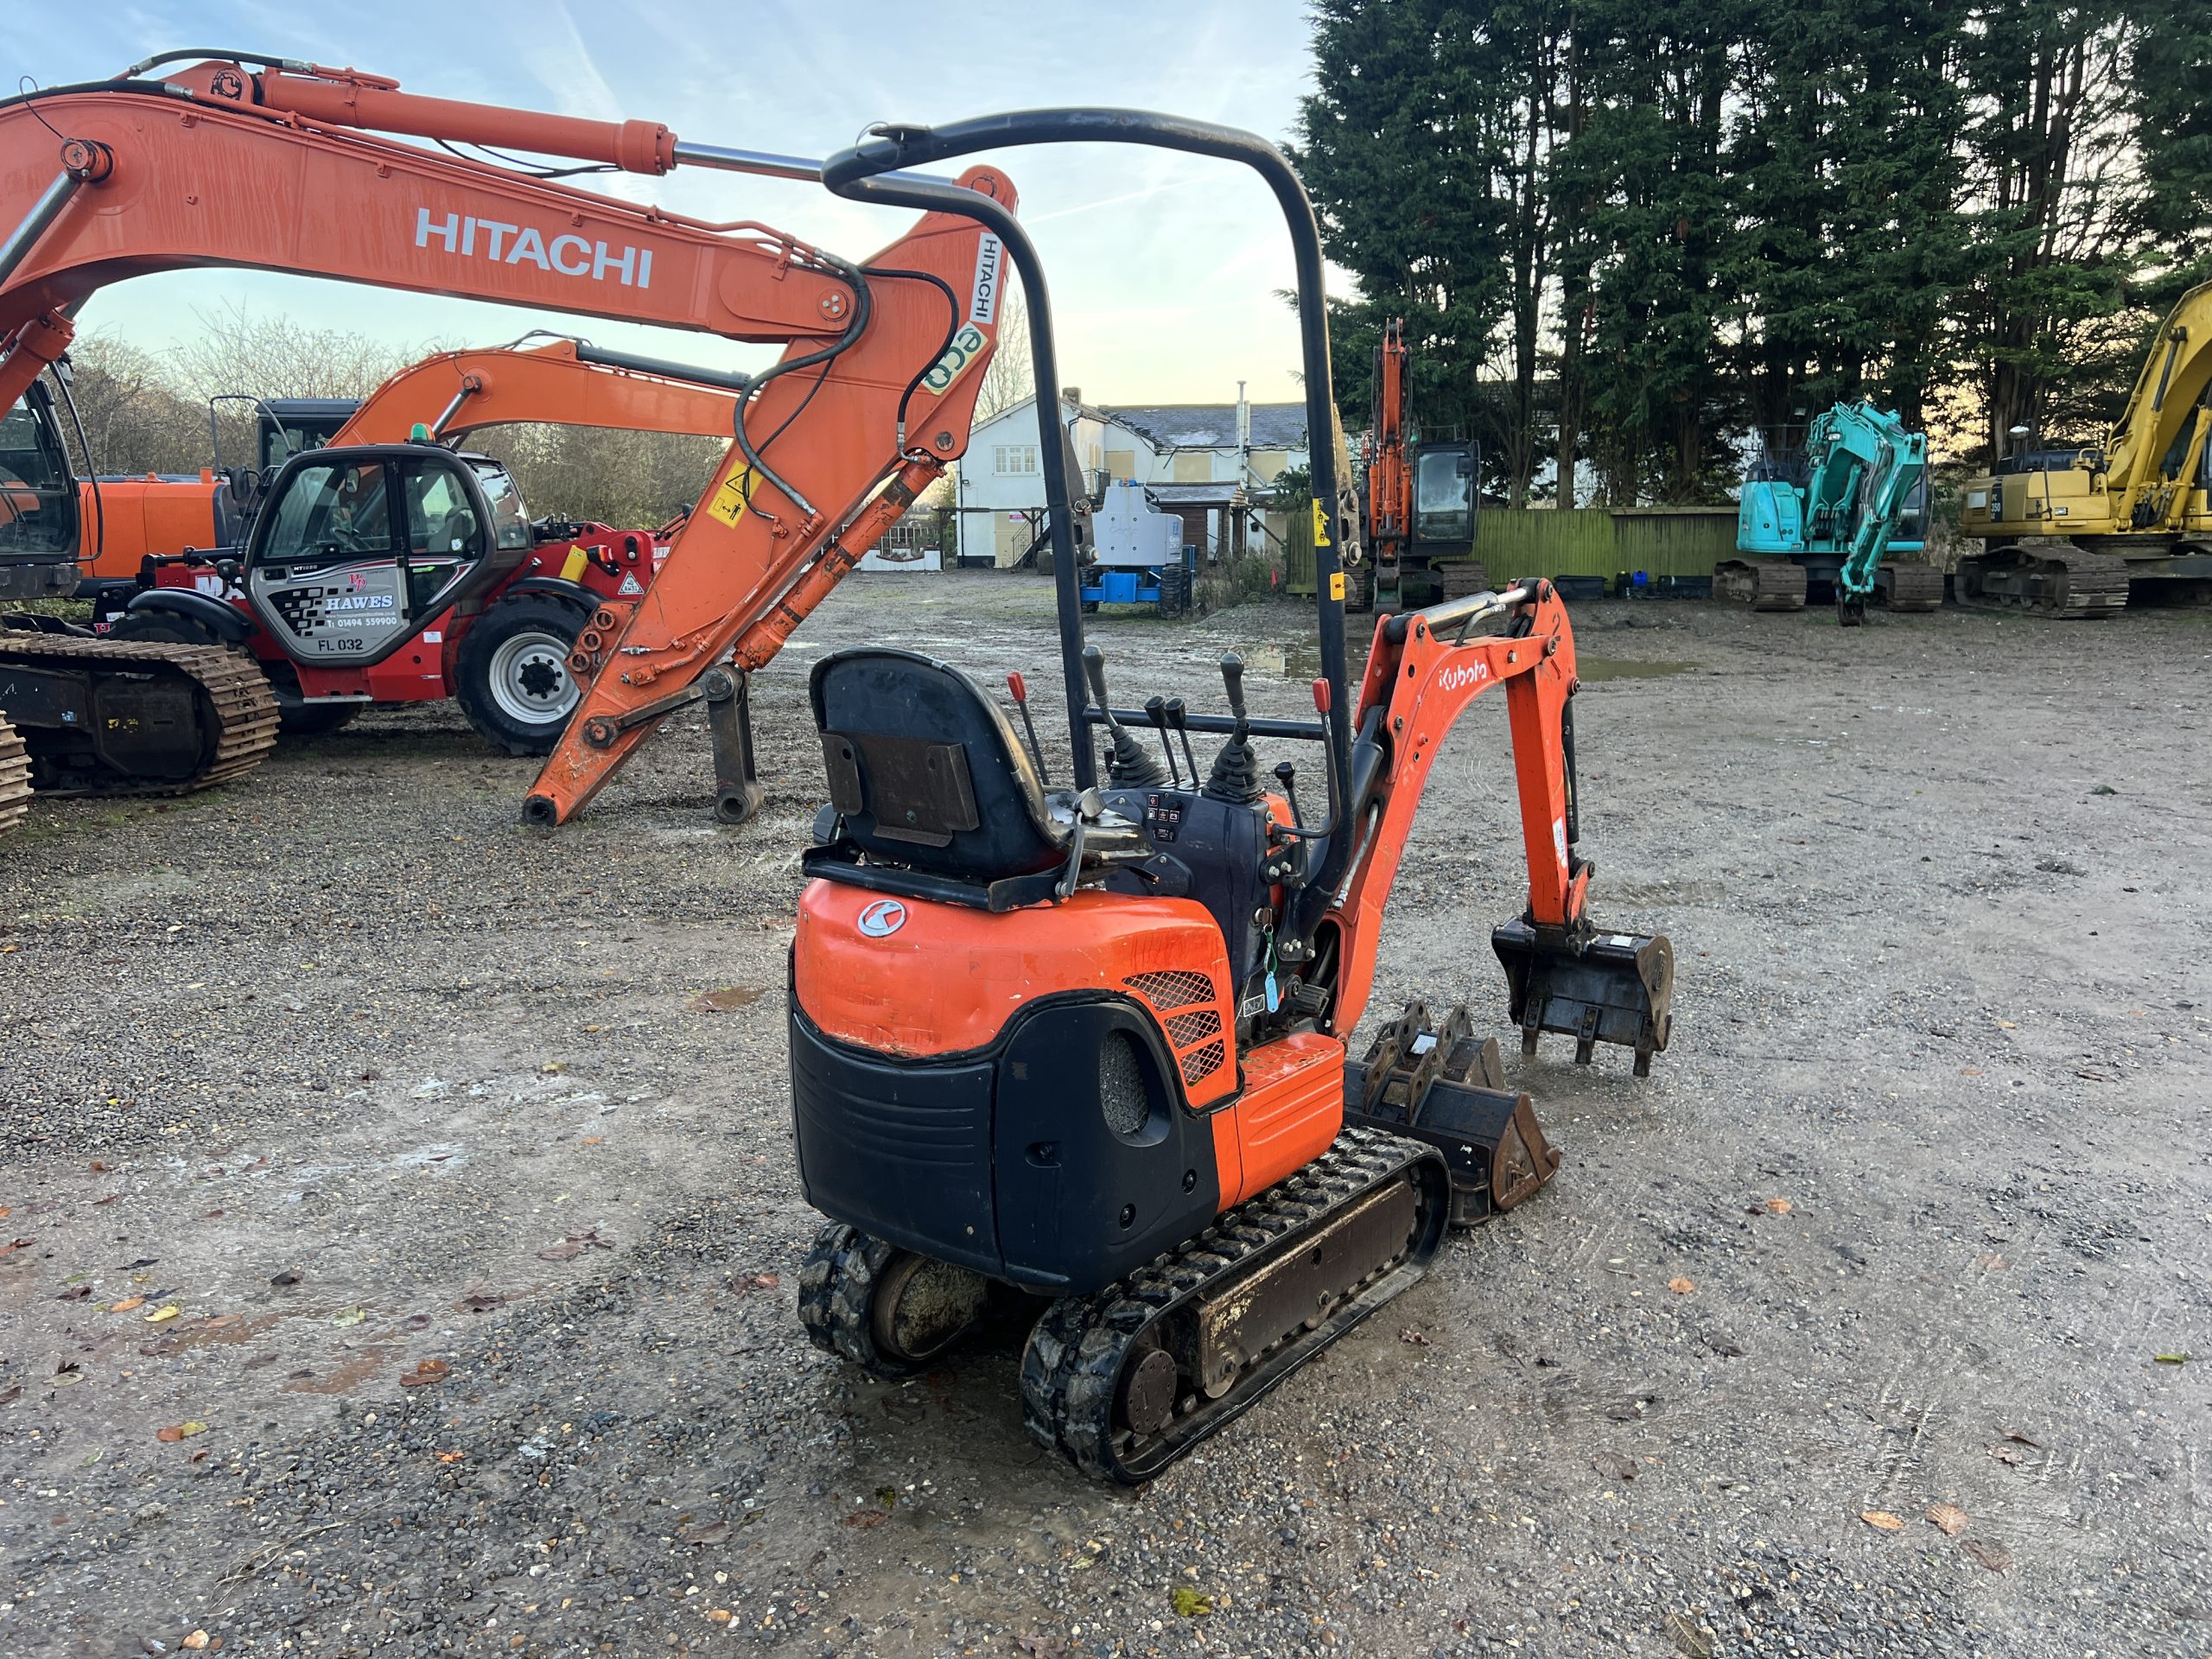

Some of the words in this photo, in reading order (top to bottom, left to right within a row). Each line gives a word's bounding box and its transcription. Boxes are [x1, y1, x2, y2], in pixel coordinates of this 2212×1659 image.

[416, 207, 653, 289] HITACHI
[975, 239, 997, 317] HITACHI
[1991, 503, 2001, 512] 350
[325, 594, 394, 611] HAWES
[338, 618, 363, 628] 01494
[365, 616, 397, 626] 559900
[318, 640, 335, 652] FL
[338, 639, 364, 651] 032
[1439, 658, 1487, 691] Kubota
